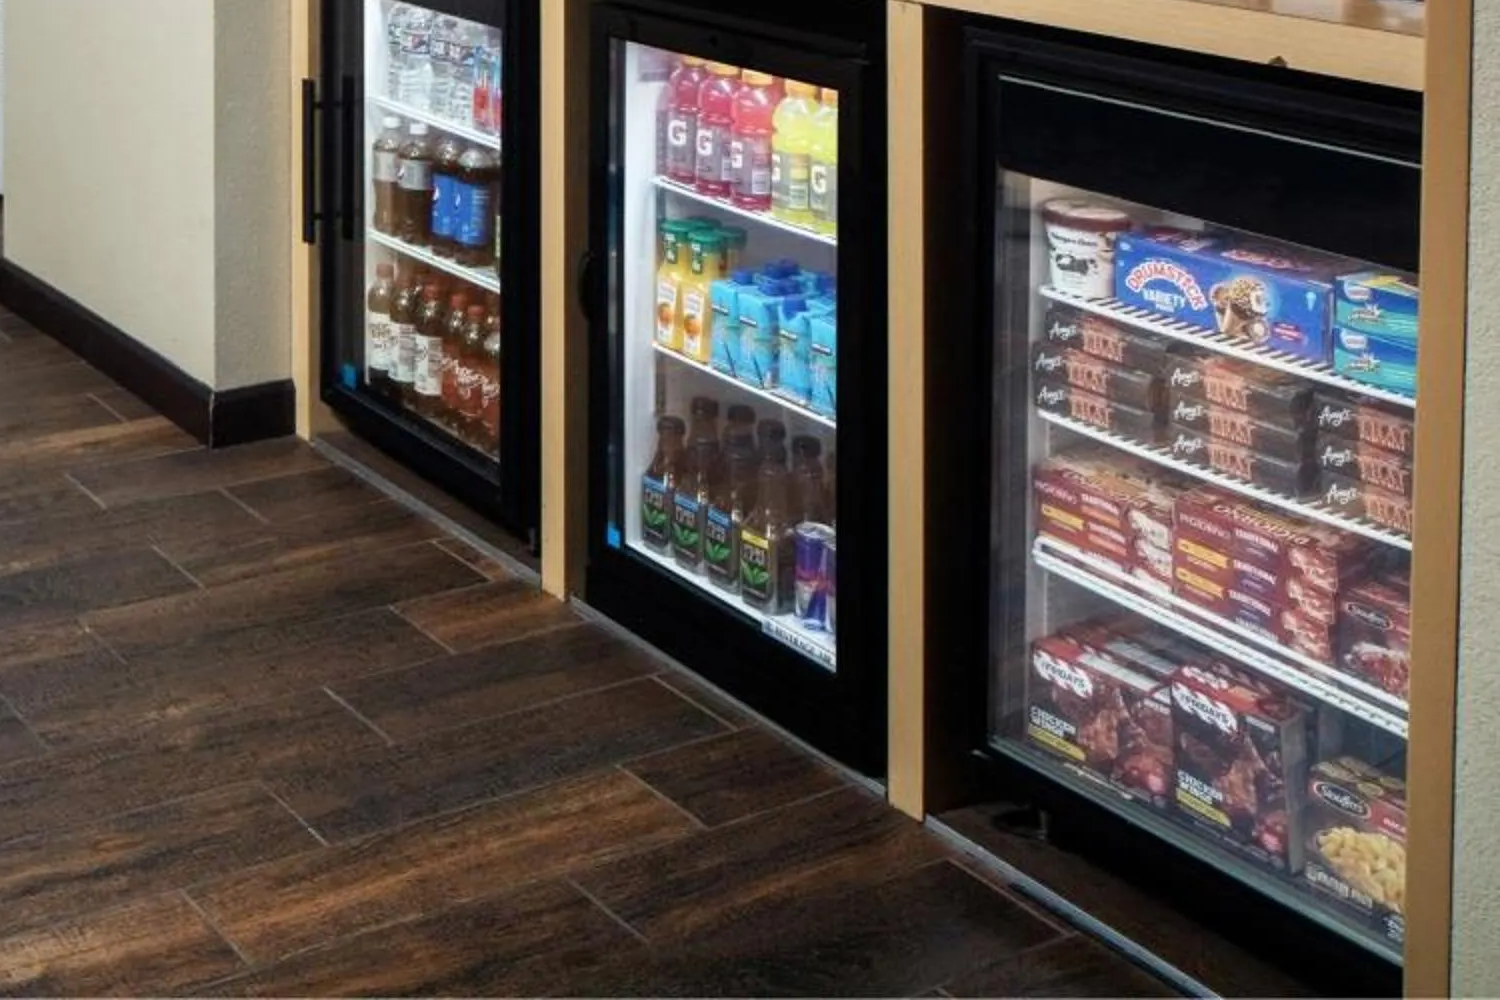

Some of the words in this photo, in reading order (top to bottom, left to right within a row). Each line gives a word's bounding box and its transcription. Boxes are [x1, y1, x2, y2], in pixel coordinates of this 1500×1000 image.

[668, 120, 687, 146] G
[696, 129, 713, 156] G
[811, 165, 827, 194] G
